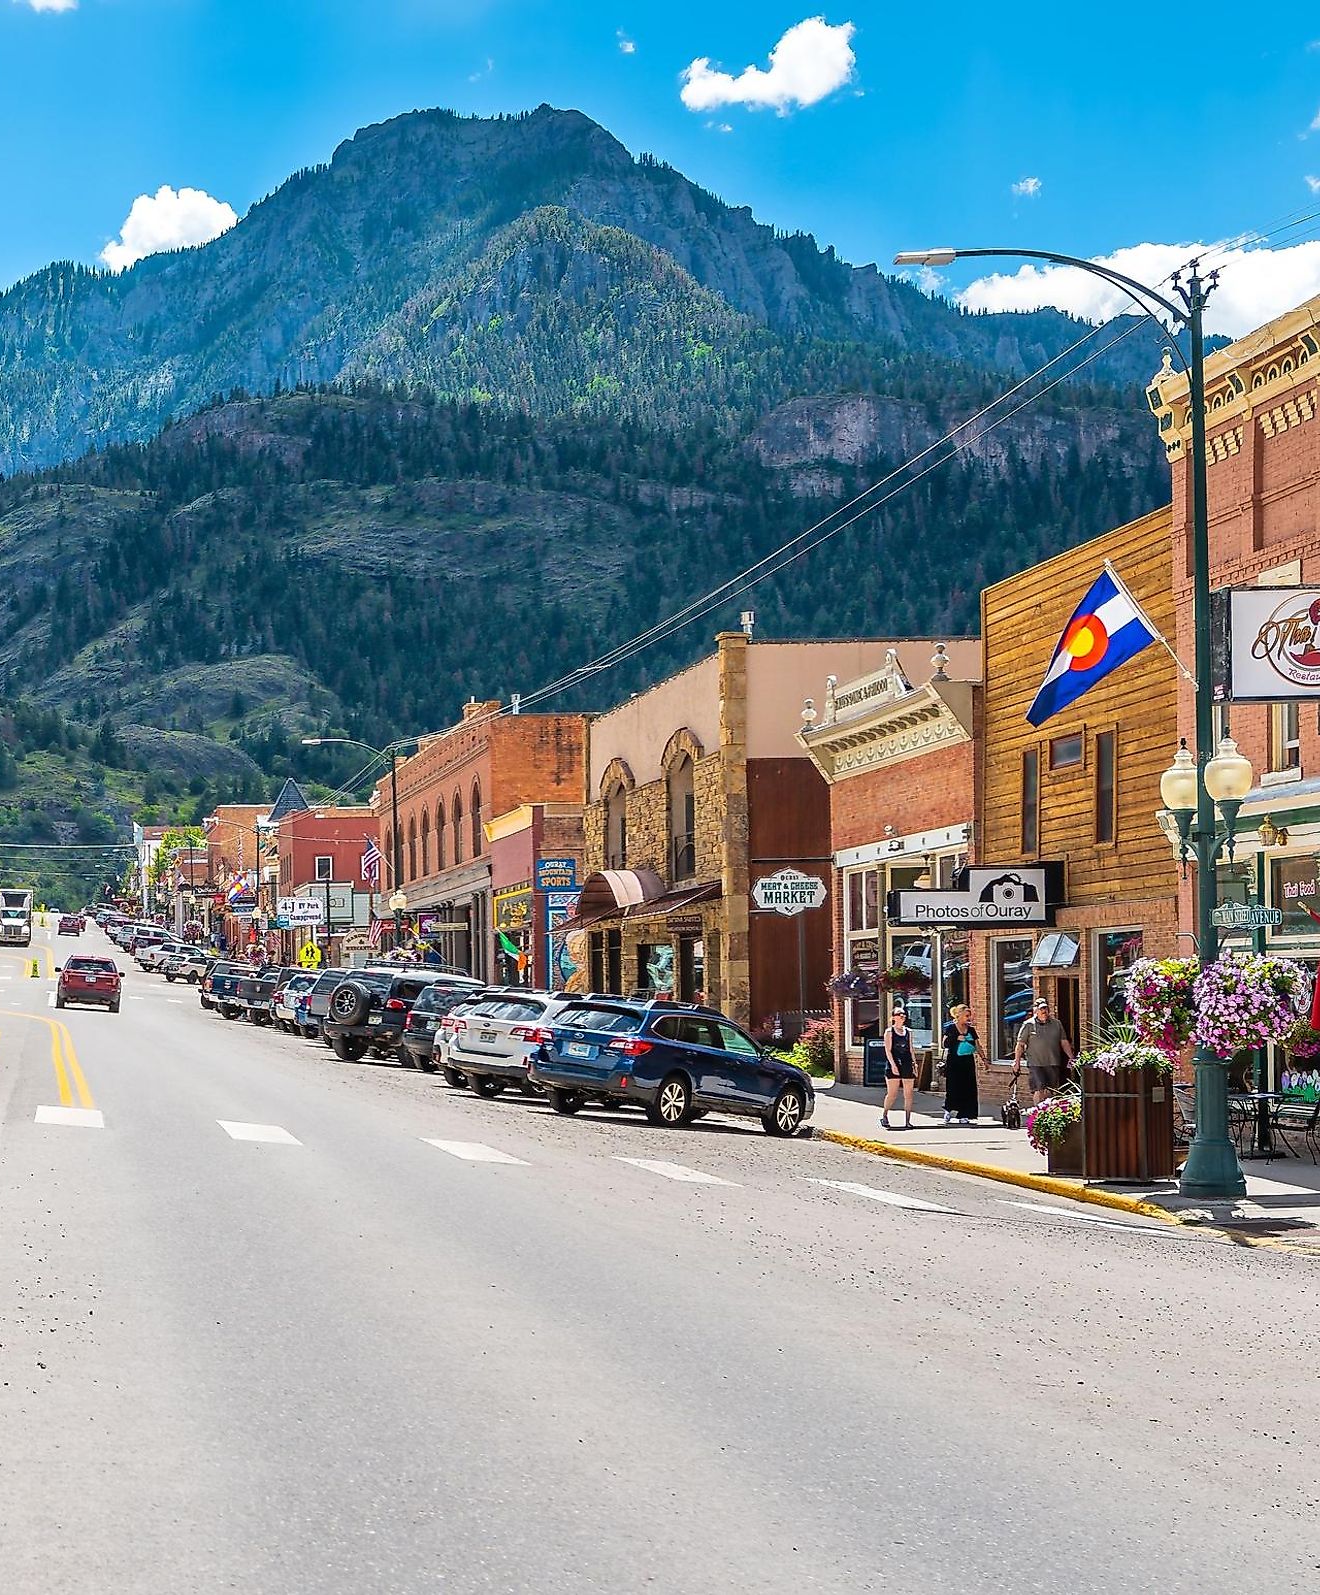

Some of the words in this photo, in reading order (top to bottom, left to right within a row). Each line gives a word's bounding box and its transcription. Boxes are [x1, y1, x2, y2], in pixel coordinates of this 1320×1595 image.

[541, 877, 571, 887] SPORTS
[761, 882, 782, 890] MEAT
[791, 882, 819, 890] CHEESE
[764, 891, 816, 903] MARKET
[915, 904, 969, 918] Photos
[970, 904, 985, 918] of
[985, 903, 1033, 919] Ouray
[289, 913, 322, 921] Campground
[1250, 911, 1279, 924] AVENUE
